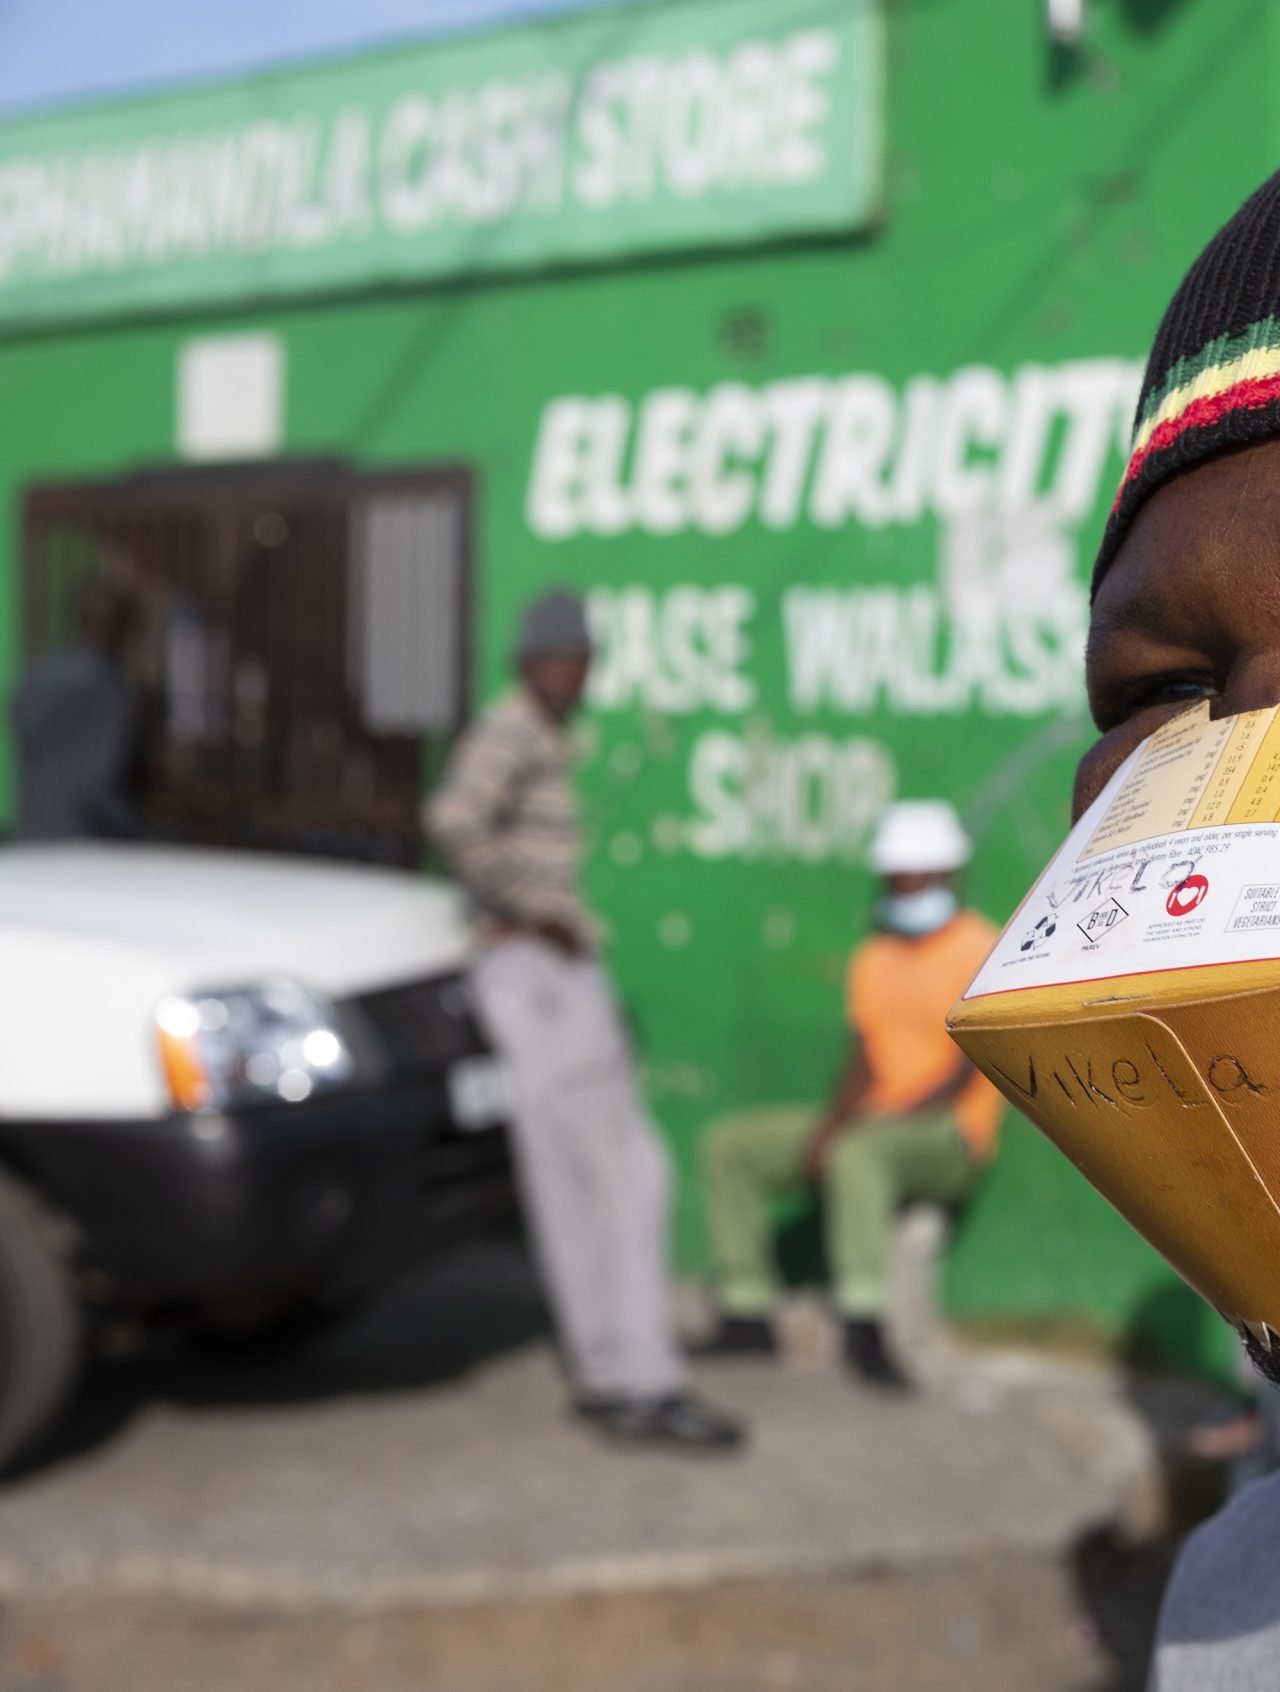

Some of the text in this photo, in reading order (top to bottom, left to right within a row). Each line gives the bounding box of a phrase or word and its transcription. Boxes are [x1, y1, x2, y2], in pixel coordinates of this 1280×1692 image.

[574, 28, 842, 212] STORE
[526, 356, 1145, 540] ELECTRICIT
[780, 582, 1092, 714] WALAS
[688, 728, 898, 865] SHOP
[1190, 834, 1203, 844] and
[1220, 832, 1234, 842] per
[1234, 829, 1253, 840] single
[1254, 829, 1279, 838] serving
[1244, 886, 1280, 900] SUITABLE
[1250, 901, 1278, 913] STRICT
